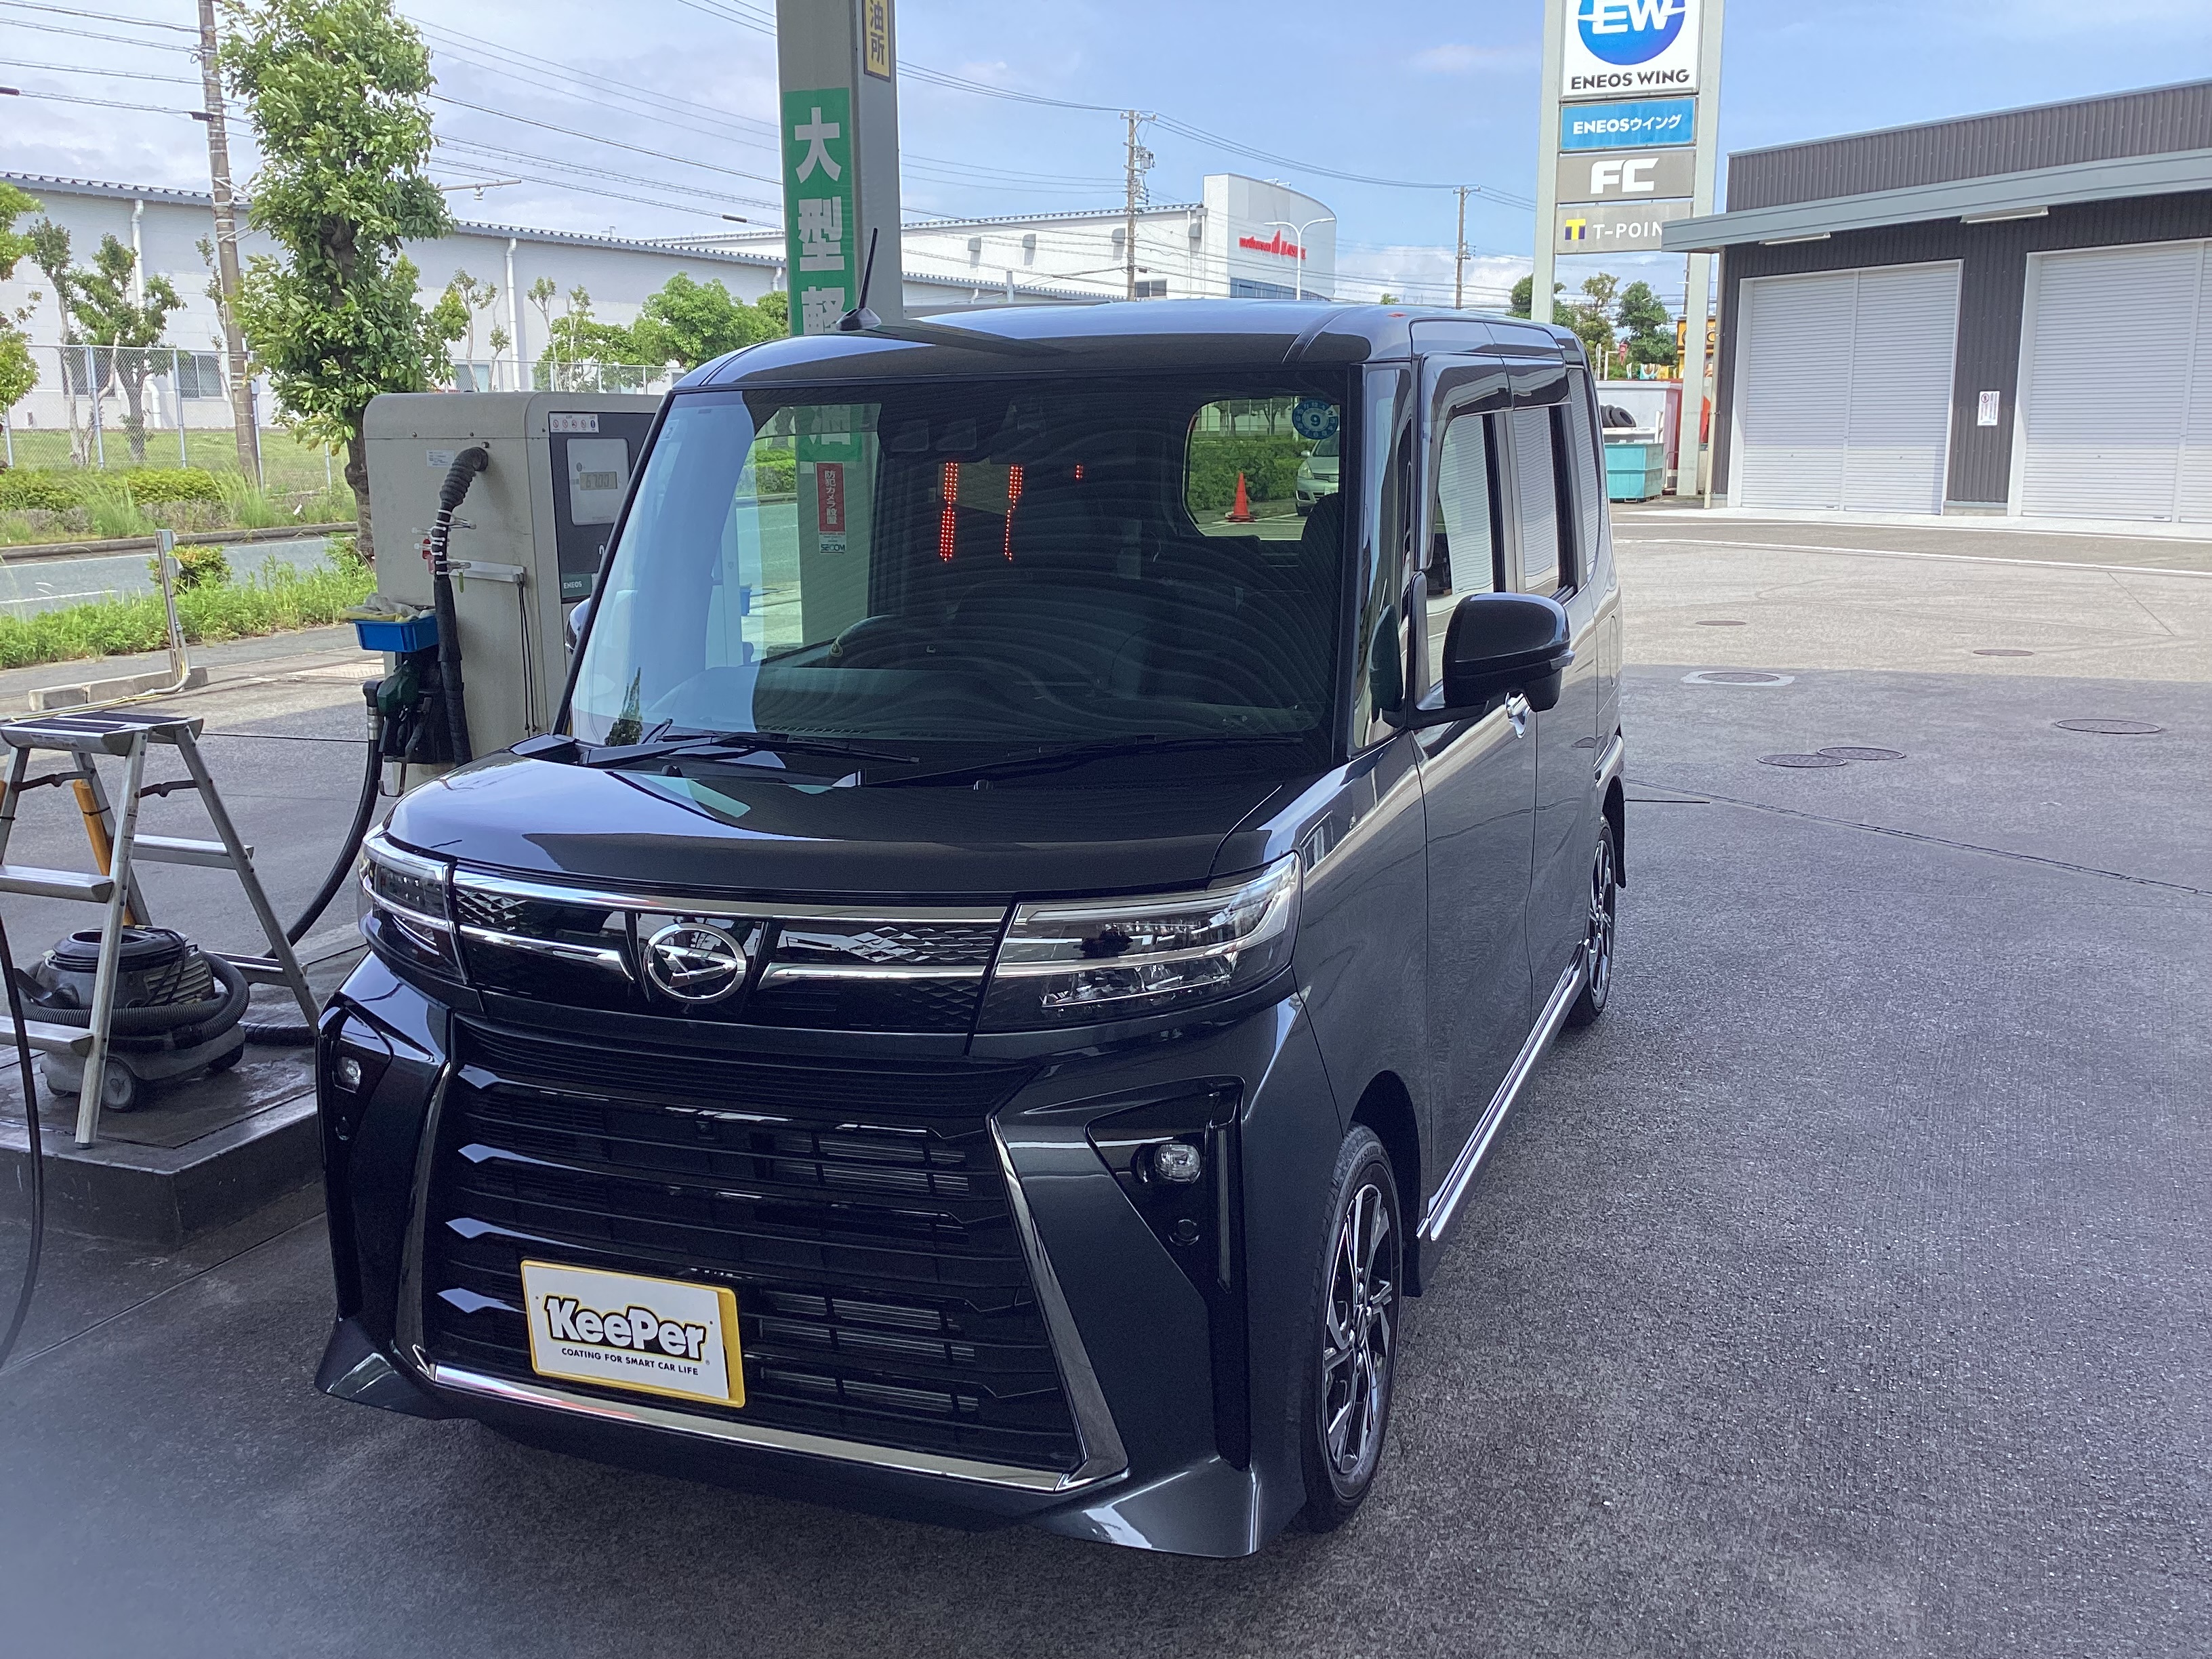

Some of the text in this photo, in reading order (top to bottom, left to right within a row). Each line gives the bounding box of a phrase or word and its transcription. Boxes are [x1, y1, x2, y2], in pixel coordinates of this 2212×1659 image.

[1593, 0, 1671, 34] EW
[869, 0, 884, 66] 油所
[1571, 68, 1689, 89] ENEOS WING
[1573, 114, 1683, 135] ENEOSウイング
[1590, 157, 1659, 194] FC
[1310, 414, 1321, 427] 9
[824, 470, 838, 525] 防犯カメラ設置
[821, 544, 845, 552] SECOM
[563, 580, 583, 589] ENEOS
[544, 1294, 707, 1362] KeePer
[561, 1347, 699, 1376] COATING FOR SMART CAR LIFE
